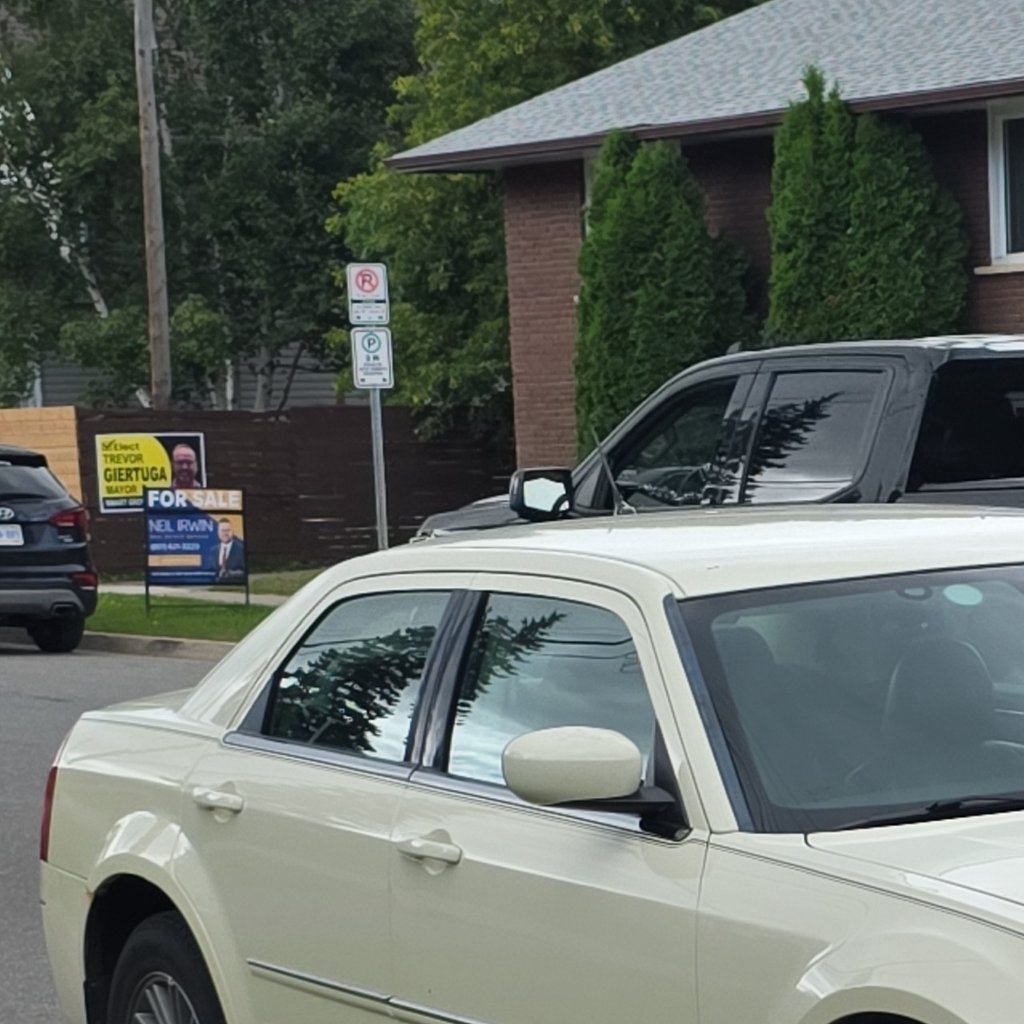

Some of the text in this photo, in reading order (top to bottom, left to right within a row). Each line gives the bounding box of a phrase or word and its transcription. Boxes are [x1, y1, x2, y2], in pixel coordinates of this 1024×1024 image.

[103, 454, 144, 464] TREVOR
[103, 466, 167, 482] GIERTUGA
[105, 485, 138, 495] MAYOR
[148, 489, 188, 508] FOR
[192, 490, 241, 510] SALE
[148, 518, 214, 533] NEIL IRWIN
